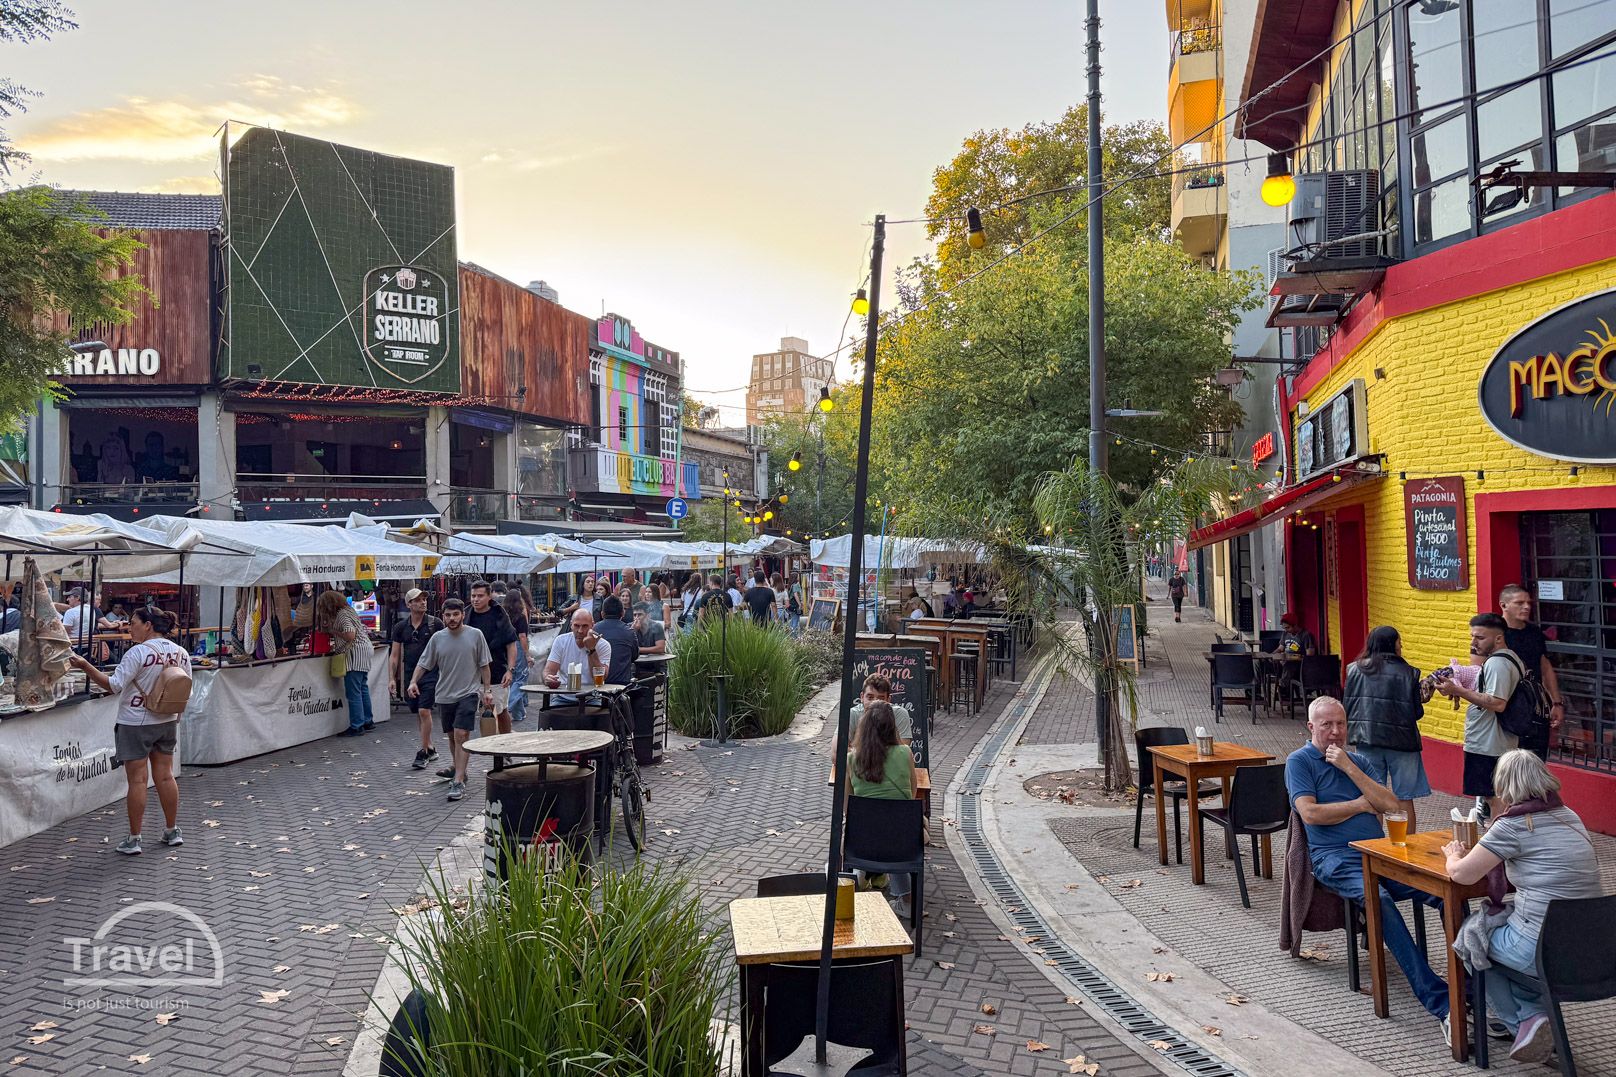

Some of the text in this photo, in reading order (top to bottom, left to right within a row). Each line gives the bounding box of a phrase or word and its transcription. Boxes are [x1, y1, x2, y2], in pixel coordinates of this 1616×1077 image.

[375, 290, 438, 316] KELLER
[374, 314, 440, 345] SERRANO
[390, 349, 424, 361] TAP ROOM
[643, 459, 664, 484] CLUB
[665, 462, 677, 485] BA
[1411, 492, 1457, 504] PATAGONIA
[671, 501, 683, 517] E
[1414, 507, 1446, 525] Pinta
[1419, 519, 1457, 533] artesanal
[1415, 545, 1441, 559] Pinta
[312, 563, 346, 574] Honduras
[375, 563, 416, 572] Feria Honduras
[287, 683, 312, 702] Ferias
[303, 697, 331, 716] Ciudad
[53, 741, 83, 762] Ferias
[76, 753, 108, 783] Ciudad
